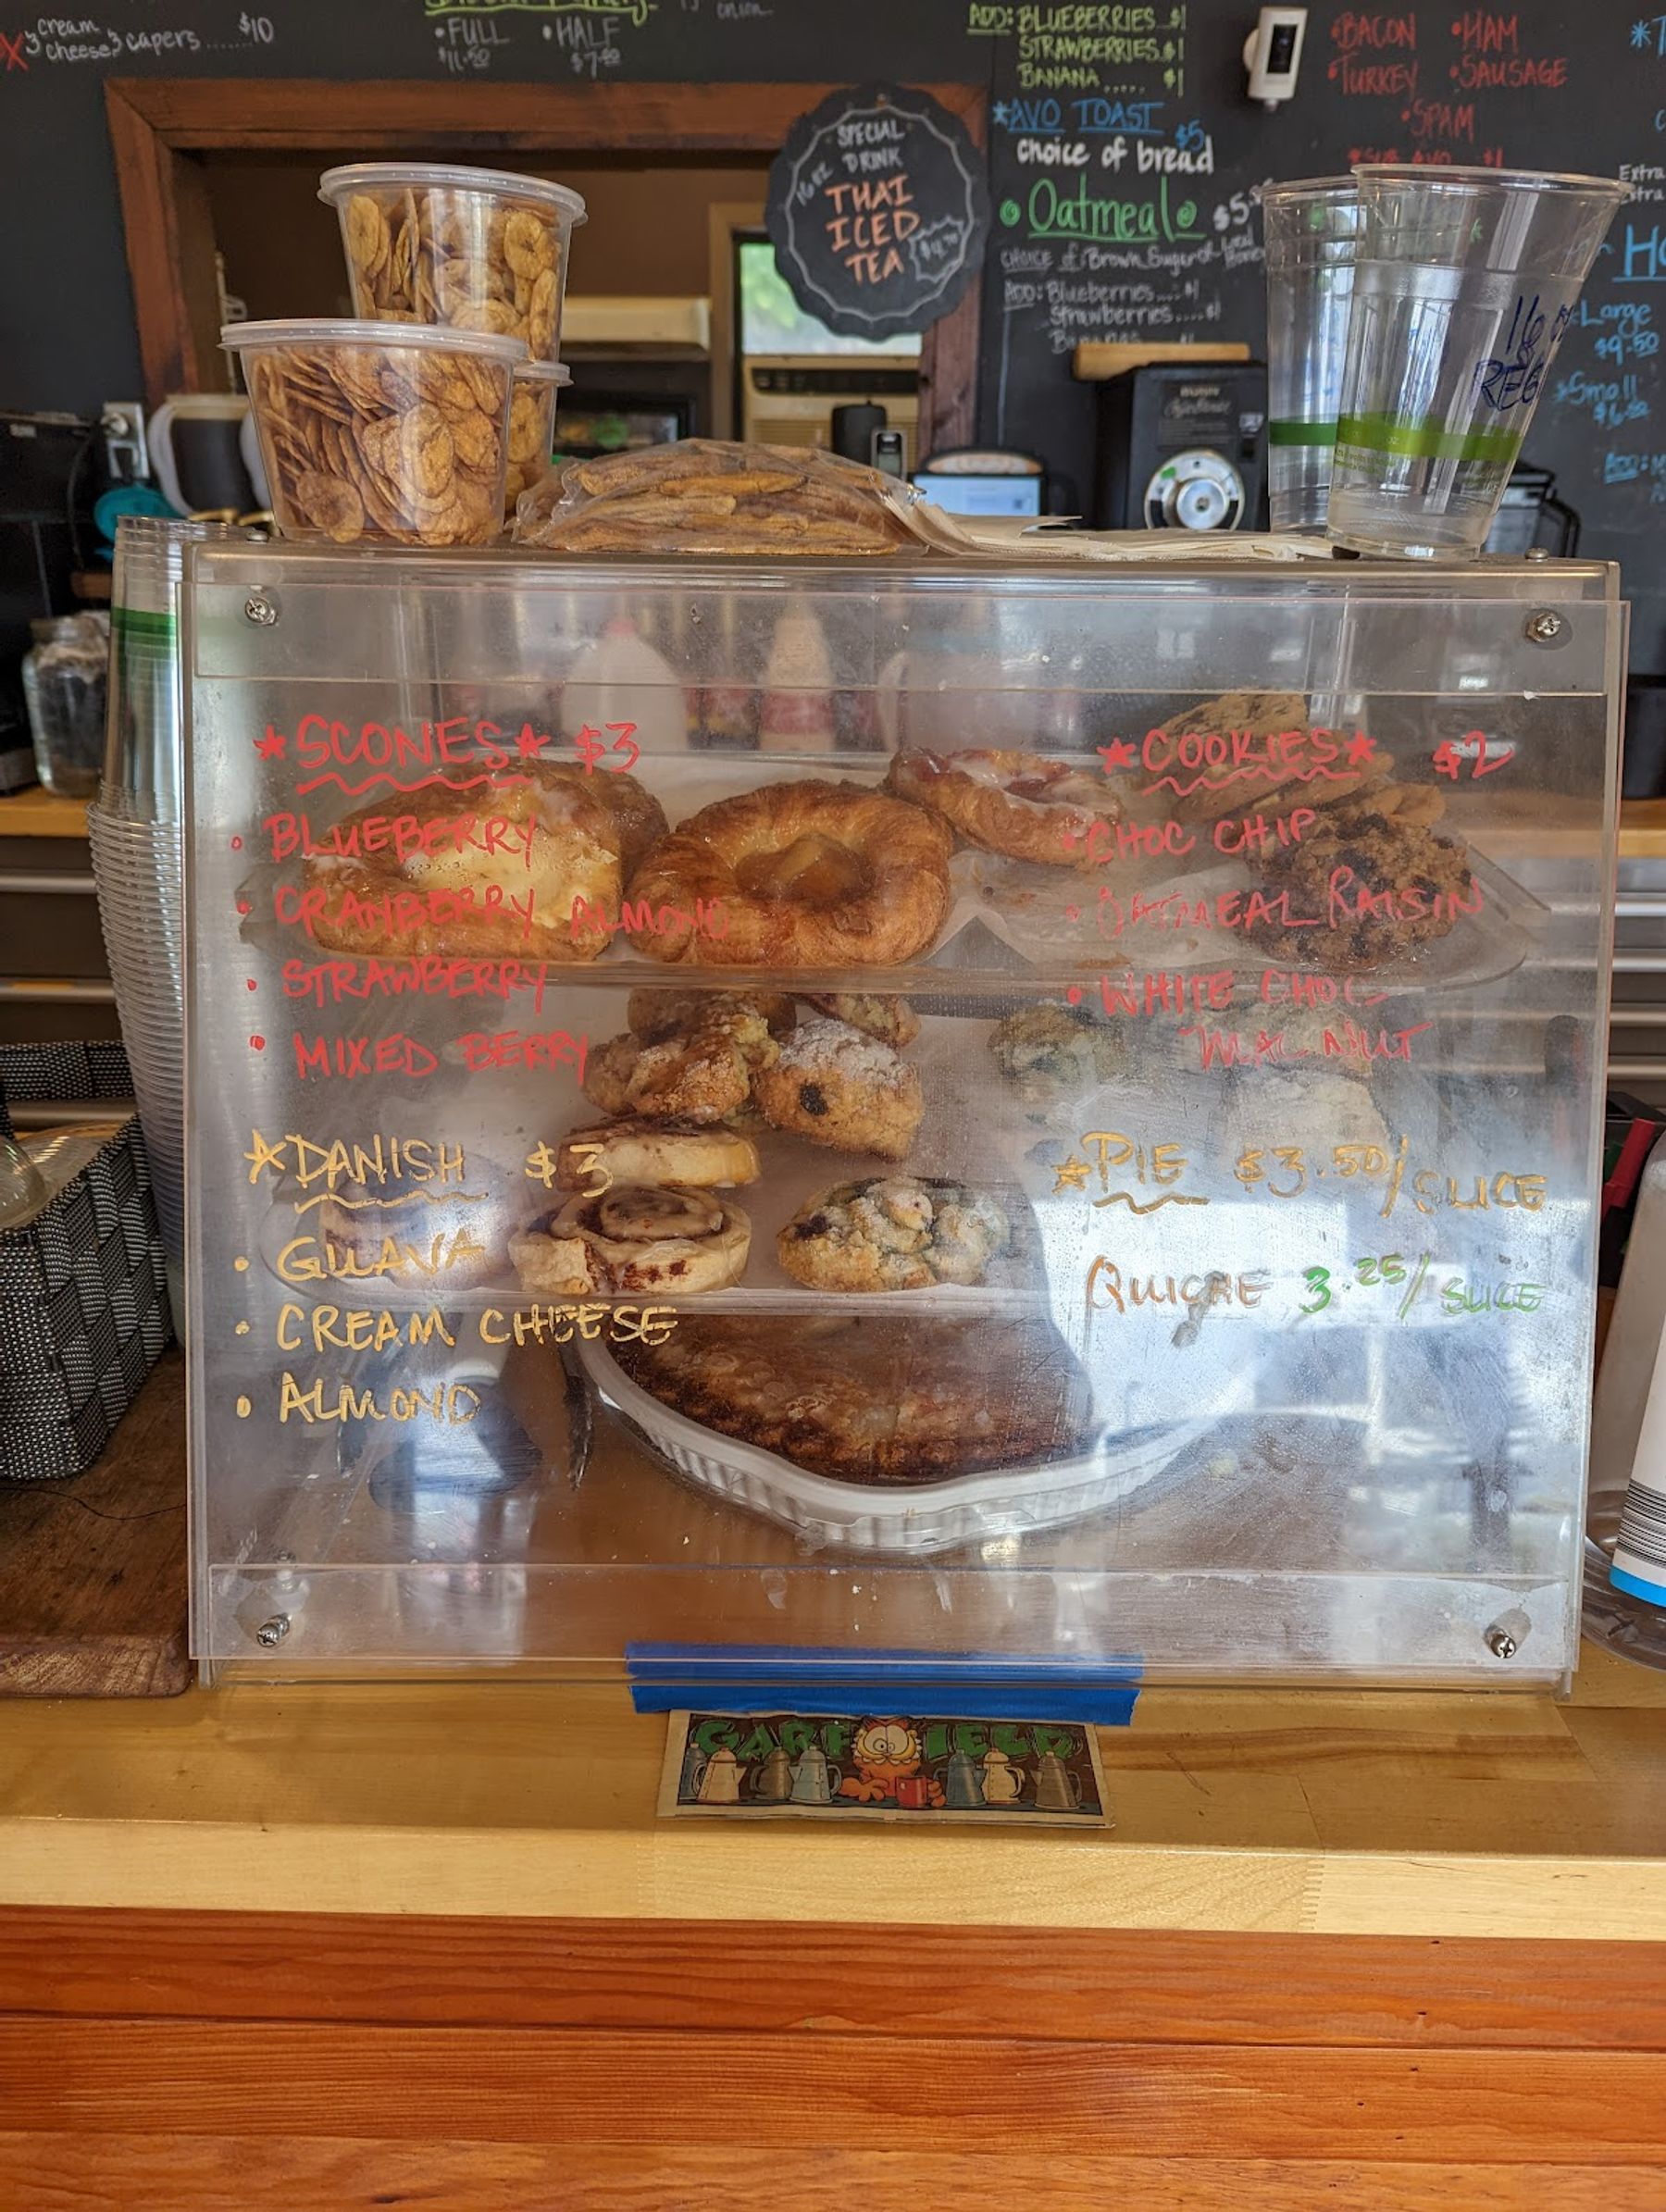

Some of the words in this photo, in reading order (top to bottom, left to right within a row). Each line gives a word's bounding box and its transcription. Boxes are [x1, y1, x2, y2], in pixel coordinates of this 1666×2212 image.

[37, 19, 100, 36] cream
[45, 41, 112, 60] cheese
[126, 29, 201, 56] capers
[239, 12, 274, 43] $10
[448, 18, 509, 45] FULL
[556, 16, 621, 47] HALF
[1018, 4, 1156, 32] BLUEBERRIES
[1337, 11, 1416, 47] BACON
[1462, 11, 1519, 53] HAM
[1019, 36, 1159, 63] STRAWBERRIES
[1018, 62, 1100, 89] BANANA
[1334, 51, 1419, 95] TURKEY
[1459, 54, 1568, 88] SAUSAGE
[837, 119, 905, 147] SPECIAL
[1008, 98, 1063, 132] AVO
[1072, 98, 1164, 133] TOAST
[1411, 98, 1474, 143] SPAM
[841, 147, 902, 174] DRINK
[1016, 138, 1090, 167] choice
[1101, 137, 1128, 168] of
[1137, 136, 1214, 173] bread
[1619, 164, 1666, 182] Extra
[824, 174, 914, 214] THAI
[1028, 172, 1175, 242] Oatmeal
[826, 211, 920, 252] ICED
[845, 247, 904, 286] TEA
[1047, 280, 1155, 304] Blueberries
[1049, 304, 1174, 328] Strawberries
[1581, 299, 1652, 339] Large
[1570, 371, 1637, 404] Small
[296, 714, 510, 770] SCONES
[574, 722, 640, 776] $3
[1140, 727, 1338, 773] COOKIES
[1431, 729, 1515, 780] $2
[262, 812, 540, 871] BLUEBERRY
[1085, 819, 1197, 864] CHOC
[1213, 808, 1317, 854] CHIP
[274, 884, 536, 939] CRANBERRY
[1327, 866, 1484, 929] RAISIN
[282, 953, 548, 1017] STRAWBERRY
[1100, 969, 1236, 1018] WHITE
[292, 1031, 440, 1079] MIXED
[456, 1029, 588, 1087] BERRY
[284, 1133, 465, 1188] DANISH
[1081, 1130, 1188, 1194] PIE
[277, 1226, 485, 1281] GUAVA
[277, 1302, 455, 1352] CREAM
[479, 1300, 678, 1347] CHEESE
[280, 1372, 482, 1425] ALMOND
